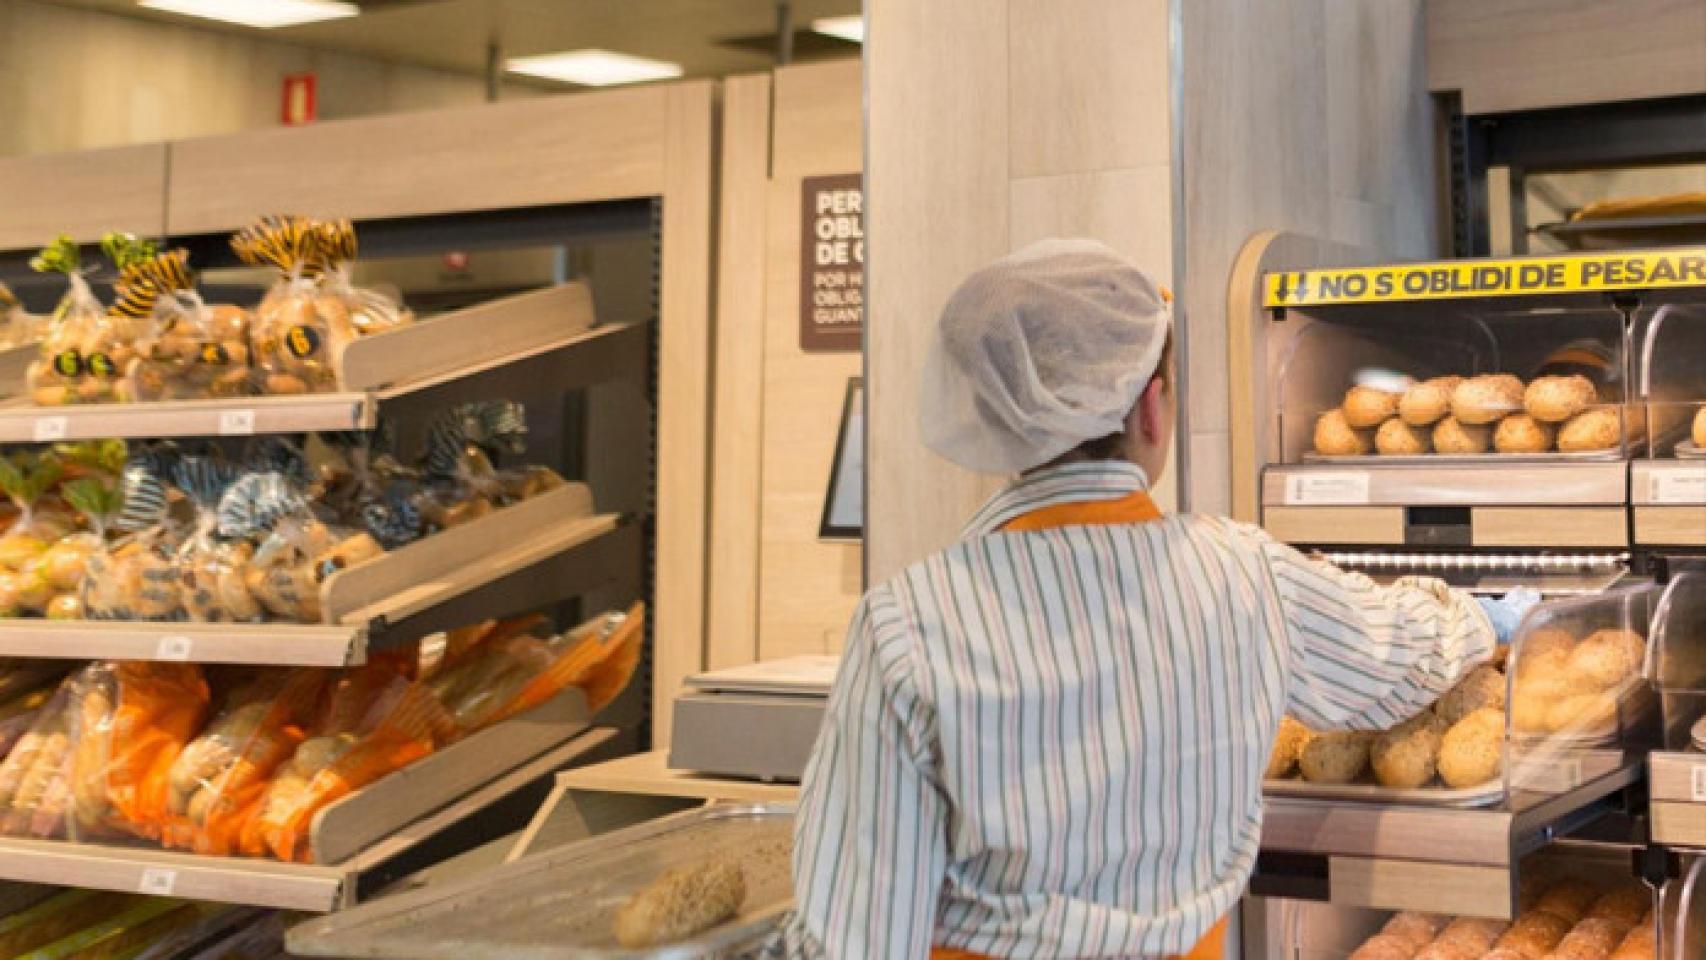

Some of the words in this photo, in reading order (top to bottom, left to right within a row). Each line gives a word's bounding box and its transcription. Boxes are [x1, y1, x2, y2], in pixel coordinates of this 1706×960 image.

[815, 190, 863, 214] PER
[815, 241, 849, 265] DE
[1319, 273, 1368, 299] NO
[1519, 264, 1566, 290] DE
[1580, 256, 1706, 286] PESAR
